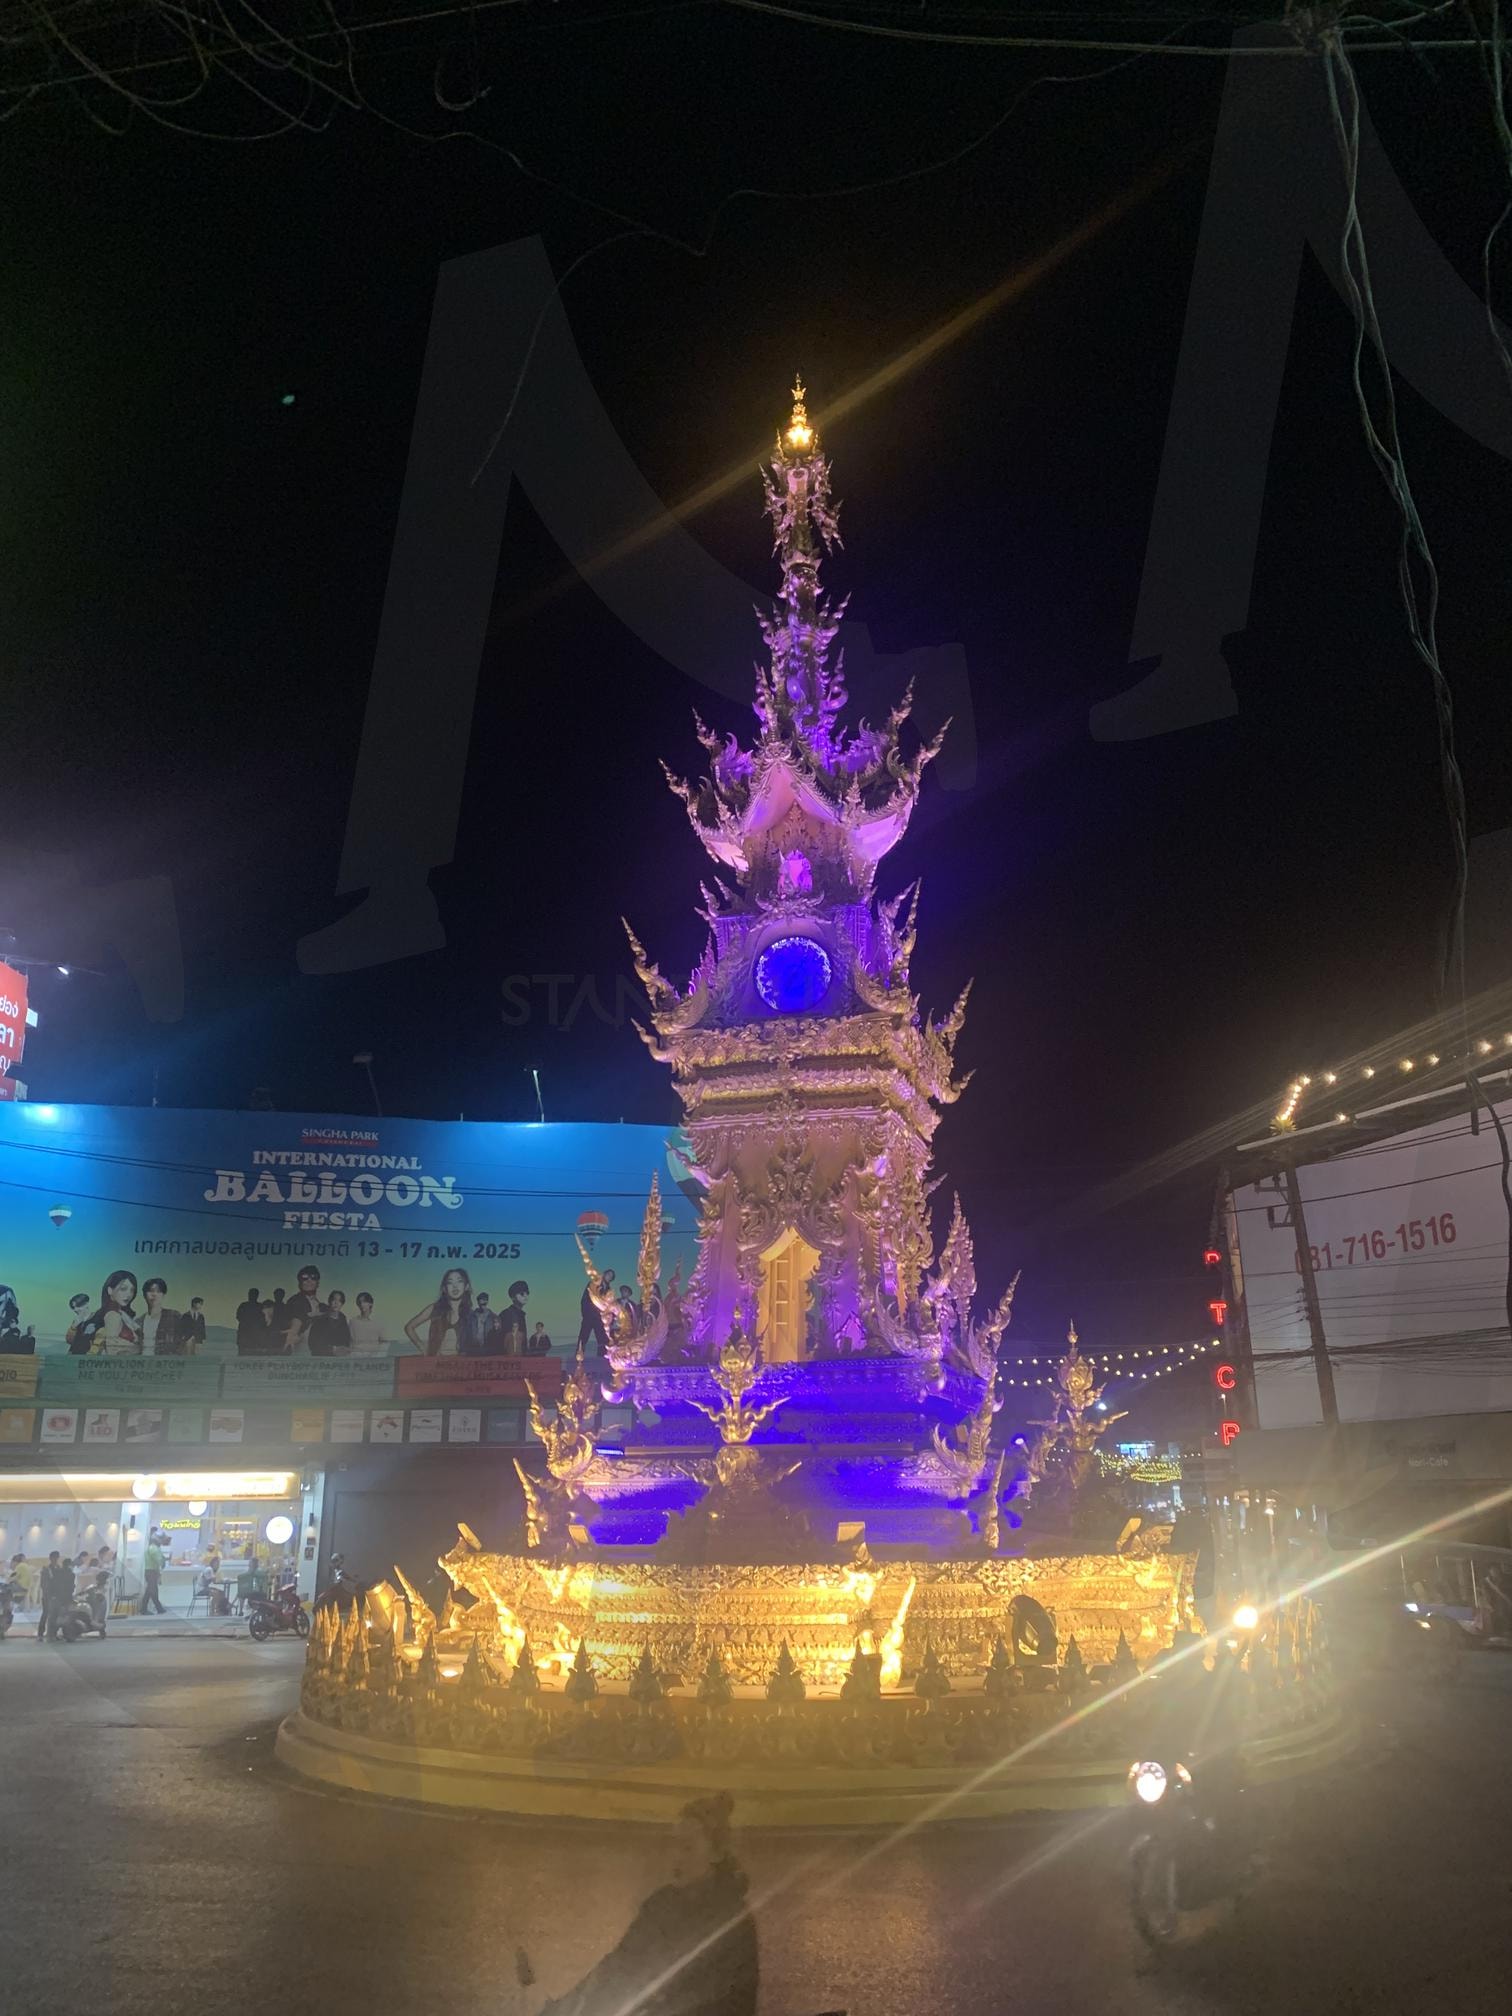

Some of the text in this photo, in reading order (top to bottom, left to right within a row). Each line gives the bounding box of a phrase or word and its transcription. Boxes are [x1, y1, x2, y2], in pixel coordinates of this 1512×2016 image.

[302, 1128, 380, 1141] SINGHA PARK
[252, 1150, 422, 1170] INTERNATIONAL
[204, 1169, 464, 1210] BALLOON
[283, 1211, 383, 1231] FIESTA
[134, 1239, 350, 1261] เทศกาลบอลลูนนานาชาติ
[358, 1241, 381, 1257] 13
[400, 1242, 422, 1258] 17
[473, 1242, 521, 1259] 2025
